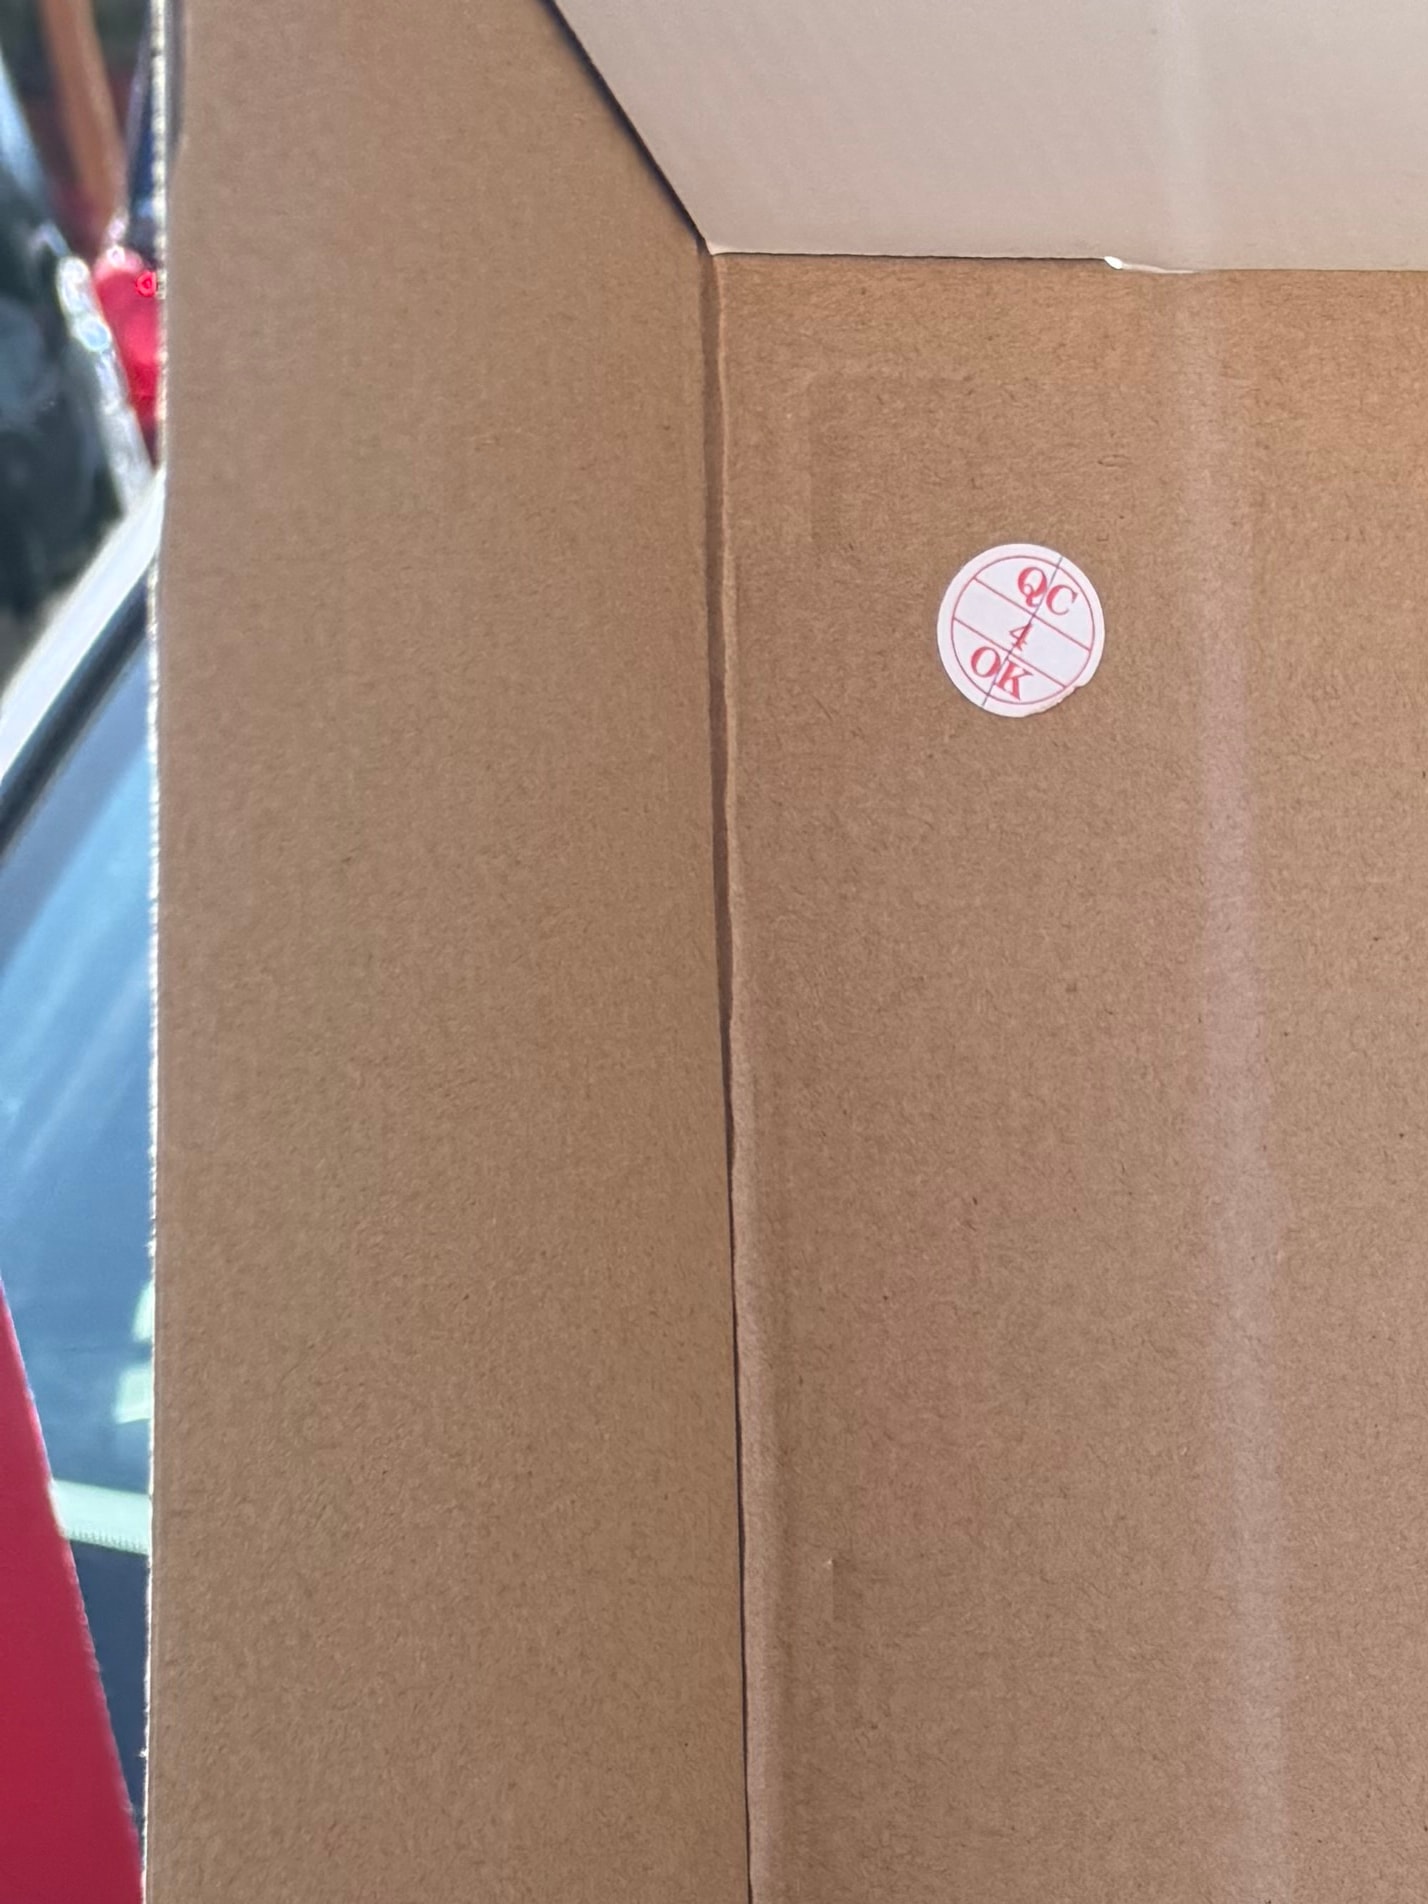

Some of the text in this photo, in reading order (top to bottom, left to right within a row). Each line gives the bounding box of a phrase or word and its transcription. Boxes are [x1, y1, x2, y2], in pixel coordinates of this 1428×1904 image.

[1017, 566, 1078, 616] QC
[1009, 623, 1033, 651] 4
[971, 646, 1033, 701] OK
